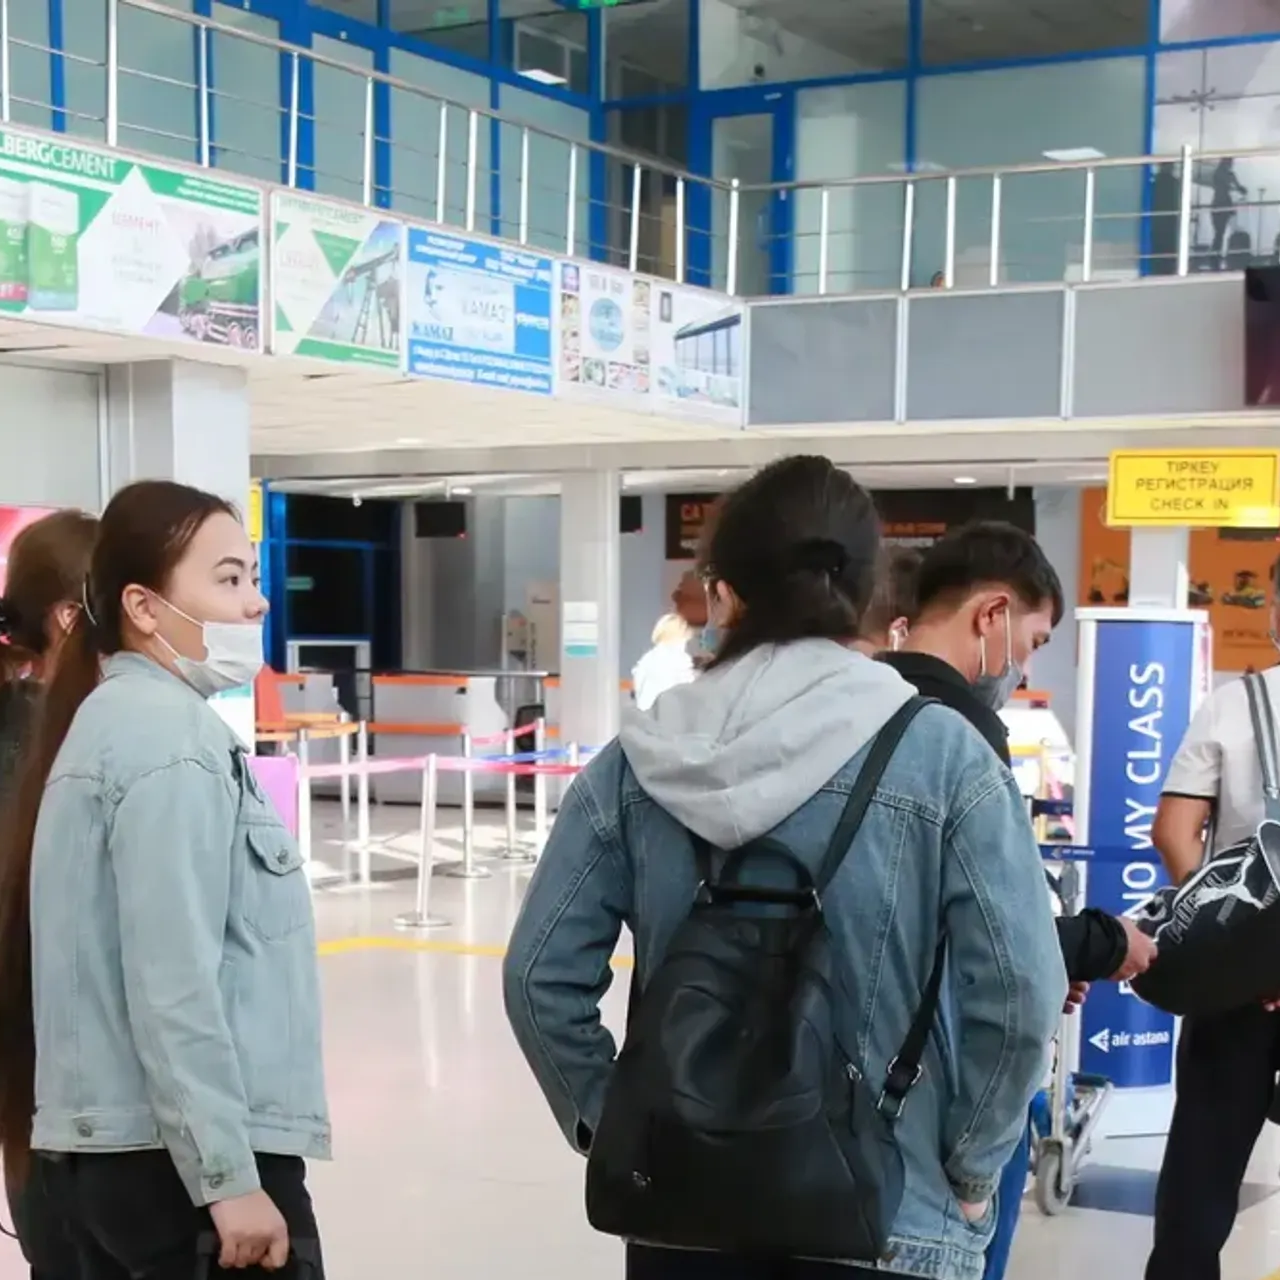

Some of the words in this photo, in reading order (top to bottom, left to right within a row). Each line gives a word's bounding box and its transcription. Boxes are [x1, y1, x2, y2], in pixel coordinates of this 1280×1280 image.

[1135, 477, 1254, 493] РЕГИСТРАЦИЯ
[1150, 498, 1205, 511] CHECK
[1212, 498, 1229, 511] IN
[1124, 660, 1166, 785] CLASS
[1111, 1030, 1131, 1047] air
[1132, 1030, 1171, 1047] astana
